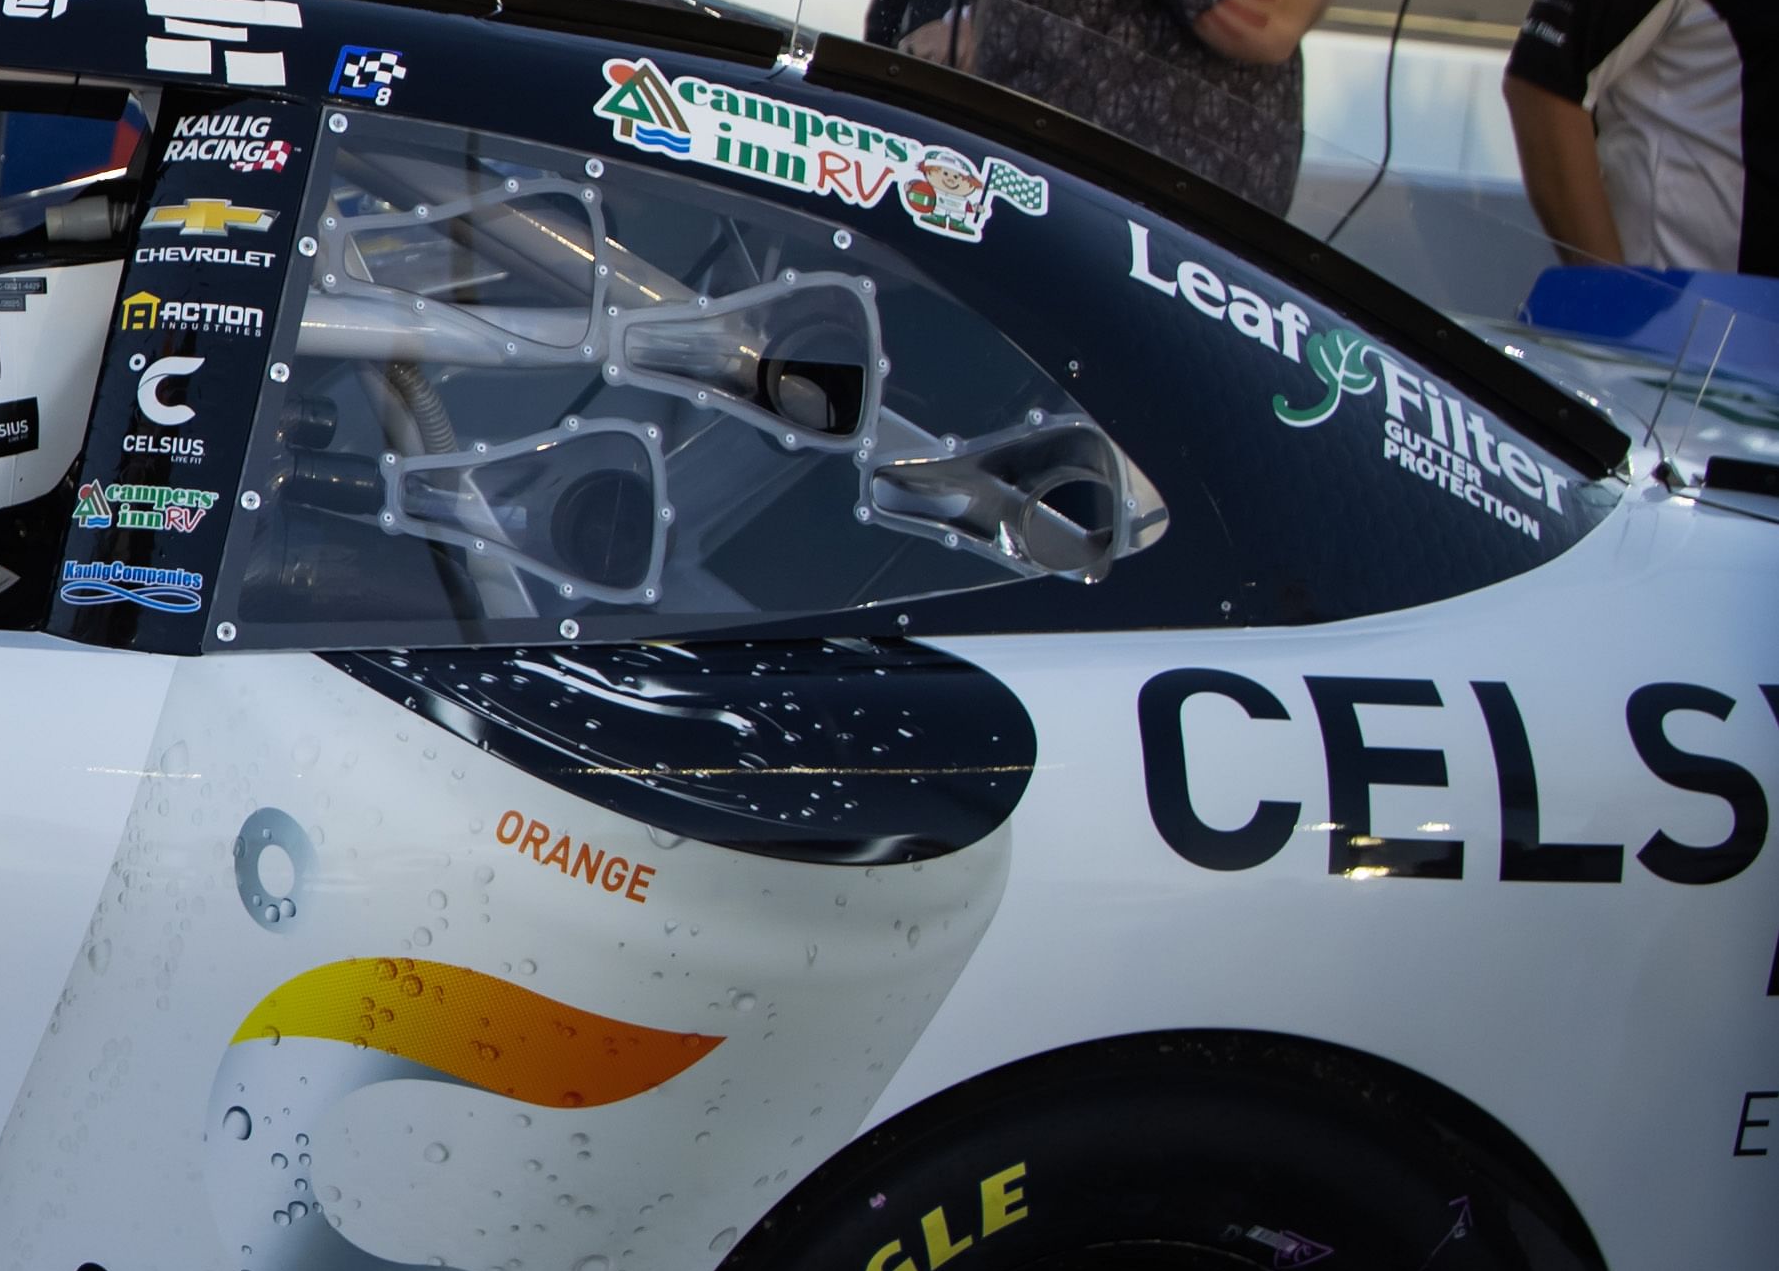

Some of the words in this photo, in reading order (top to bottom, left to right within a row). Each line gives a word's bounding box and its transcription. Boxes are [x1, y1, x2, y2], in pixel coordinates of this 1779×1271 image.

[172, 115, 272, 139] KAULIG
[678, 81, 908, 163] campers
[162, 139, 266, 162] RACING
[714, 121, 808, 186] inn
[817, 151, 895, 202] RV
[135, 247, 276, 268] CHEVROLET
[160, 302, 264, 327] ACTION
[161, 322, 262, 338] INDUSTRIES
[1126, 220, 1311, 365] Leaf
[1378, 356, 1568, 516] Filter
[122, 434, 205, 456] CELSIUS
[1383, 419, 1482, 489] GUTTER
[104, 483, 219, 510] campers
[1383, 441, 1541, 541] PROTECTION
[117, 504, 163, 529] inn
[165, 507, 206, 532] RV
[1137, 667, 1779, 886] CELS
[494, 808, 657, 905] ORANGE
